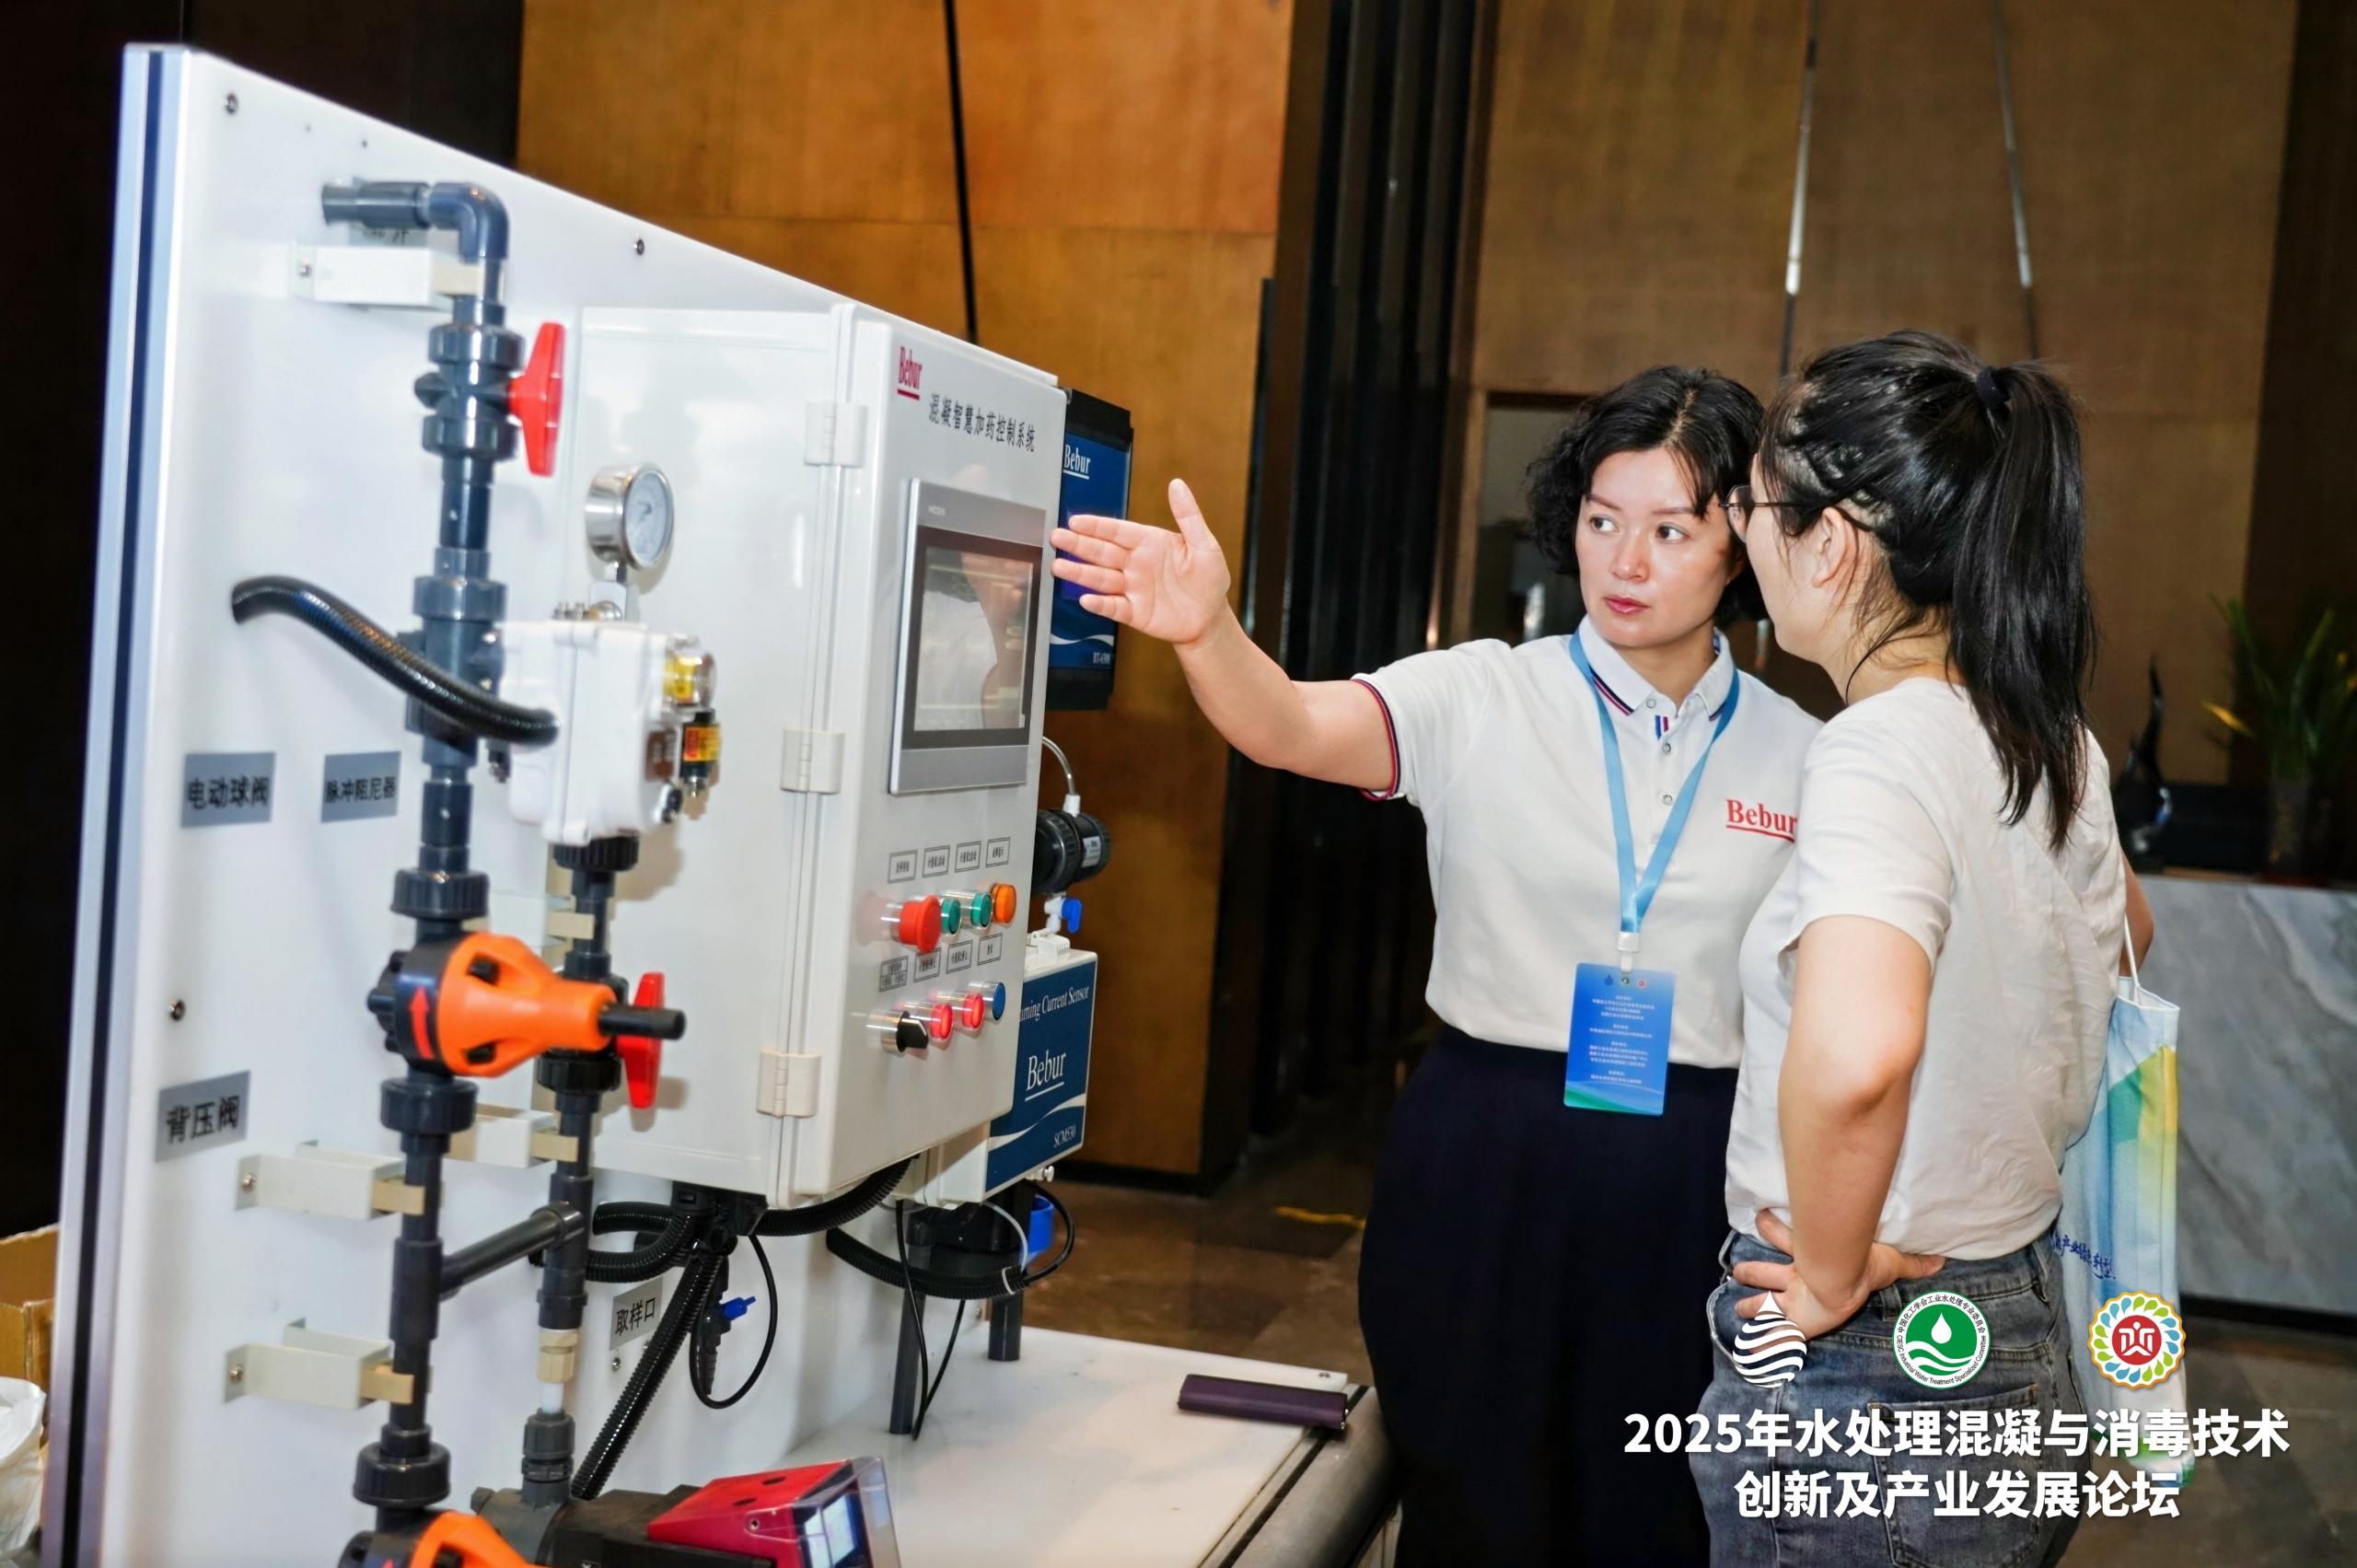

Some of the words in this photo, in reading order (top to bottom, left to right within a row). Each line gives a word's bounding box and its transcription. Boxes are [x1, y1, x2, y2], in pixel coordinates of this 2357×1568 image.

[899, 346, 922, 389] Bebur
[929, 392, 1035, 452] 混凝智慧加药控制系统
[1064, 444, 1090, 474] Bebur
[187, 775, 270, 810] 电动球阀
[325, 776, 397, 804] 脉冲阻尼器
[1725, 798, 1797, 835] Bebur
[1042, 991, 1068, 1014] Current
[1068, 986, 1090, 1005] Sensor
[1026, 1050, 1066, 1092] Bebur
[166, 1095, 240, 1144] 背压阀
[615, 1297, 656, 1336] 取样口
